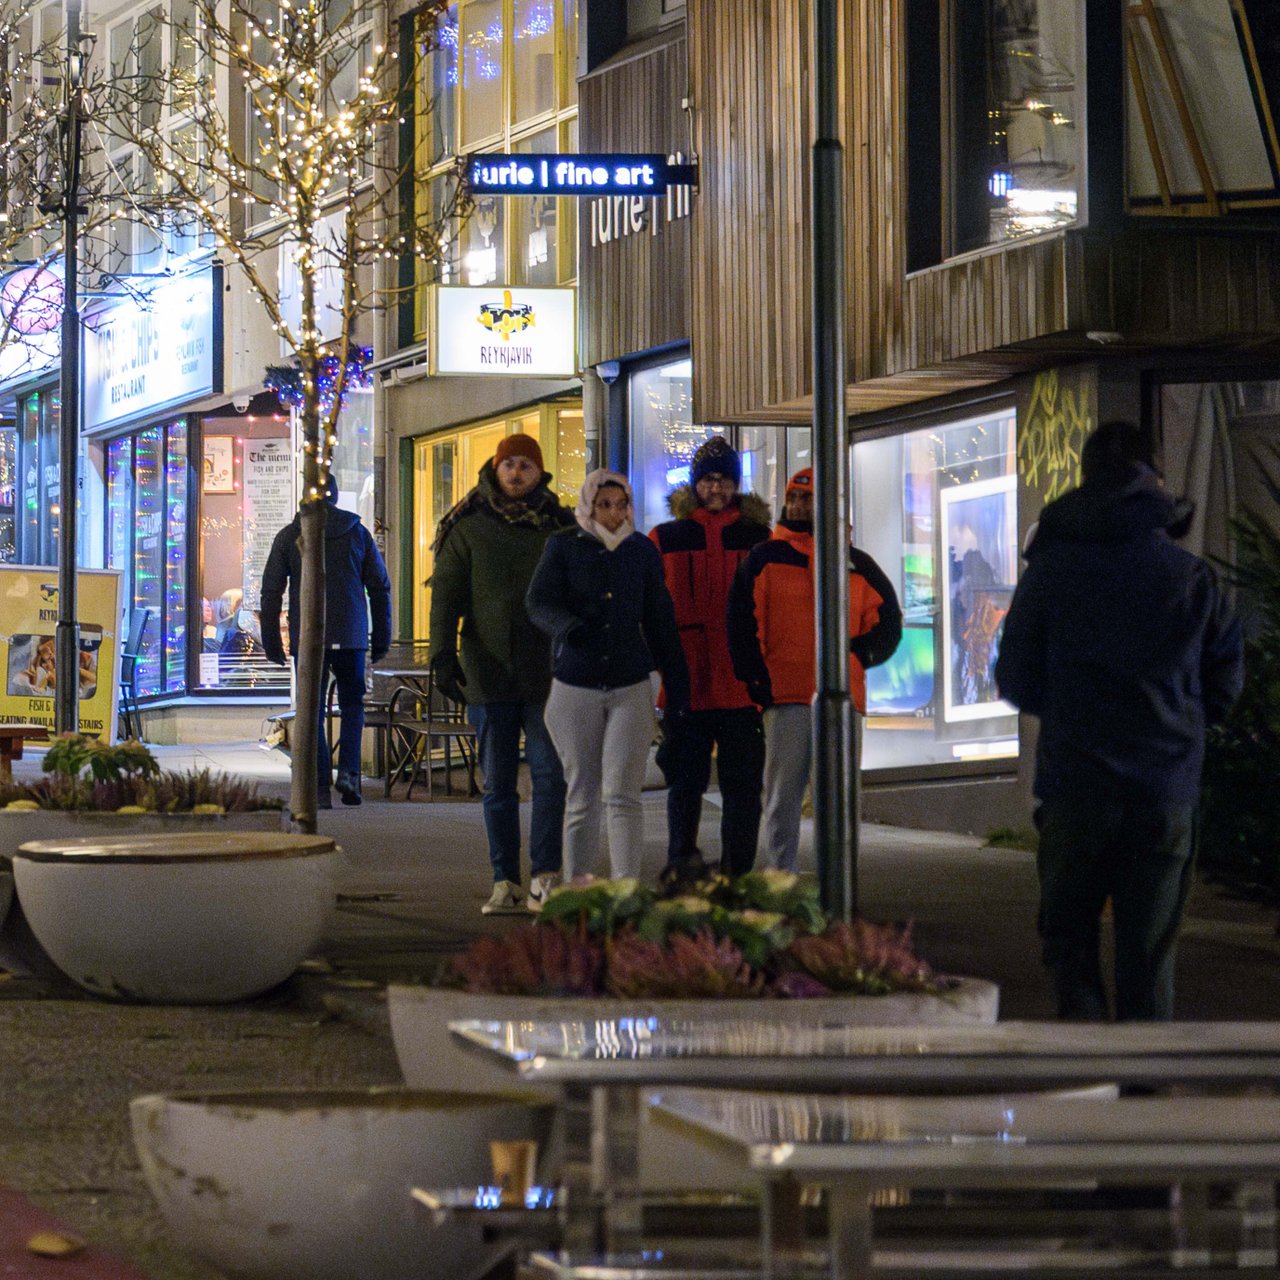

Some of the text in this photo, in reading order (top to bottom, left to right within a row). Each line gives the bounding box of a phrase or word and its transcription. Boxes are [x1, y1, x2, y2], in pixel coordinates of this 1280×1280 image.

[472, 162, 534, 186] iurie
[555, 161, 609, 186] fine
[614, 164, 654, 186] art
[480, 346, 532, 368] REYKJAVIK
[111, 374, 145, 404] RESTAURANT
[249, 452, 266, 463] The
[29, 699, 44, 711] FISH
